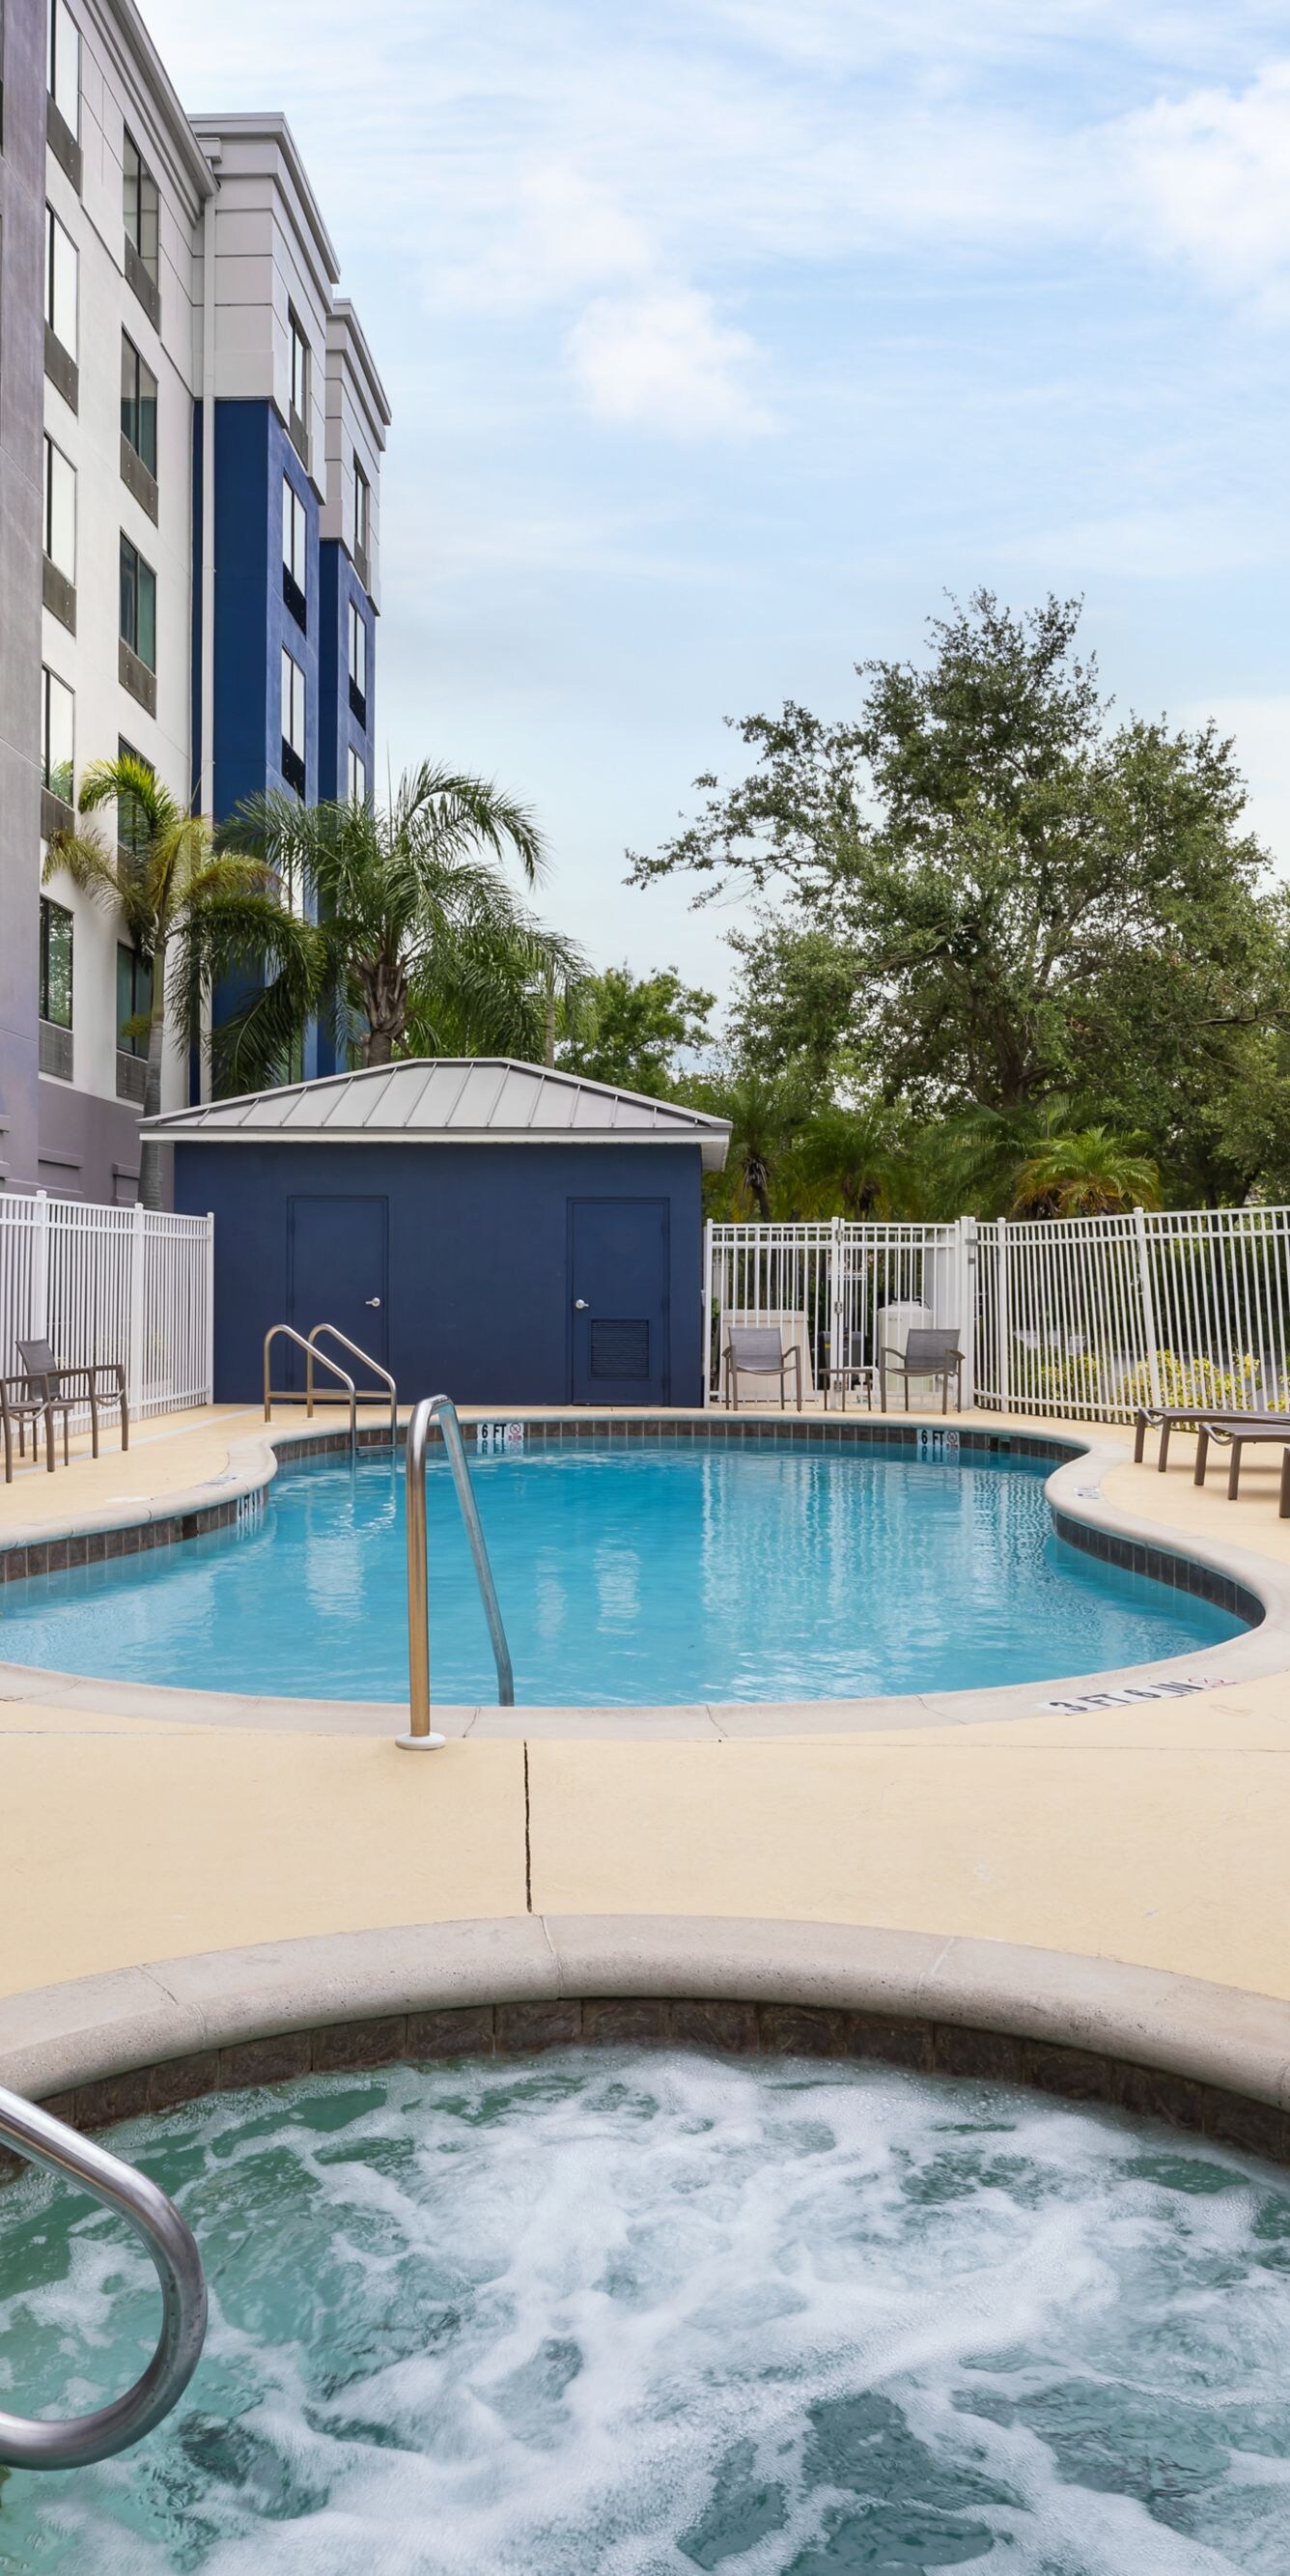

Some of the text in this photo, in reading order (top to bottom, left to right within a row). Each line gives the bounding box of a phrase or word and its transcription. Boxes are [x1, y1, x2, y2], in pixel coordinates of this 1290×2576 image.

[482, 1424, 507, 1439] 6 FT
[921, 1430, 944, 1446] 6 FT
[1050, 1701, 1088, 1712] 3
[1076, 1693, 1130, 1706] FT
[1124, 1689, 1162, 1698] 6
[1148, 1682, 1205, 1693] IN
